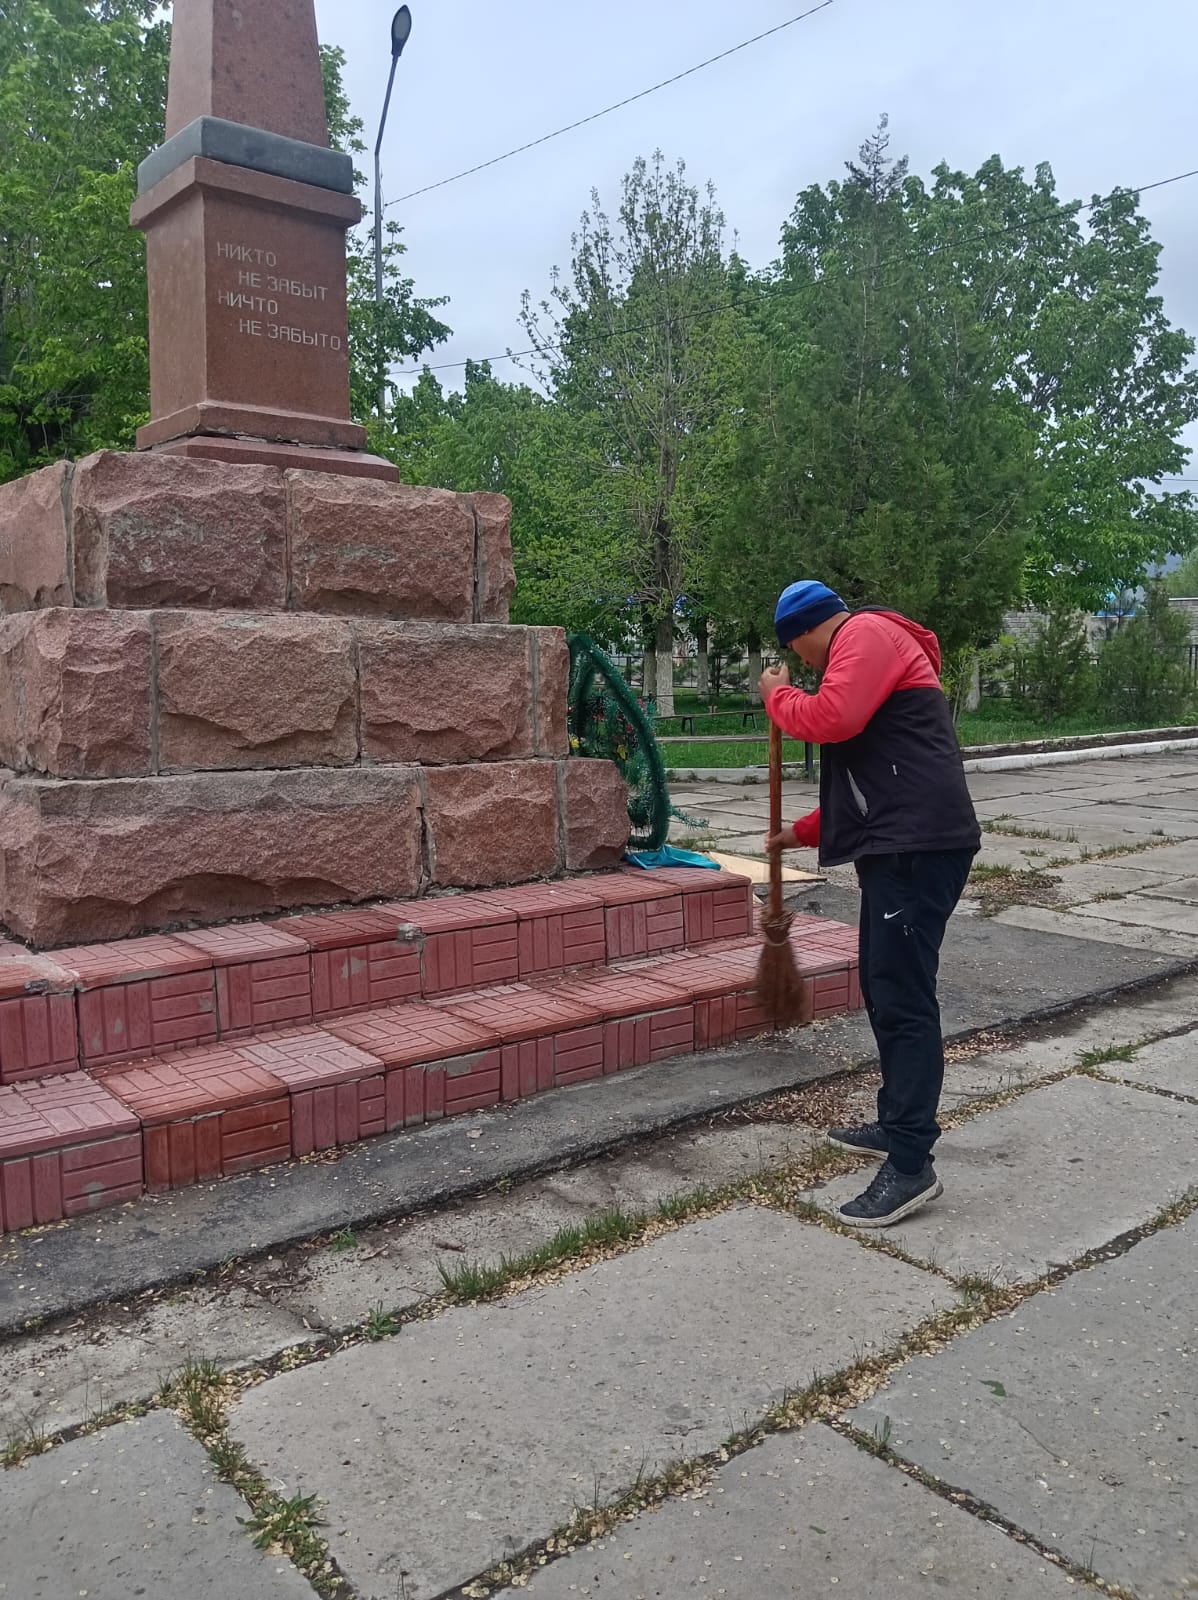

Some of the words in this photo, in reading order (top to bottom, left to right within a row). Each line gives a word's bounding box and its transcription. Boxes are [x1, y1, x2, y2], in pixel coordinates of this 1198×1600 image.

[217, 241, 277, 267] НИКТО
[239, 271, 261, 288] НЕ
[267, 275, 328, 301] ЗАБЫТ
[218, 289, 278, 315] НИЧТО
[239, 318, 262, 336] НЕ
[267, 322, 341, 351] ЗАБЫТО
